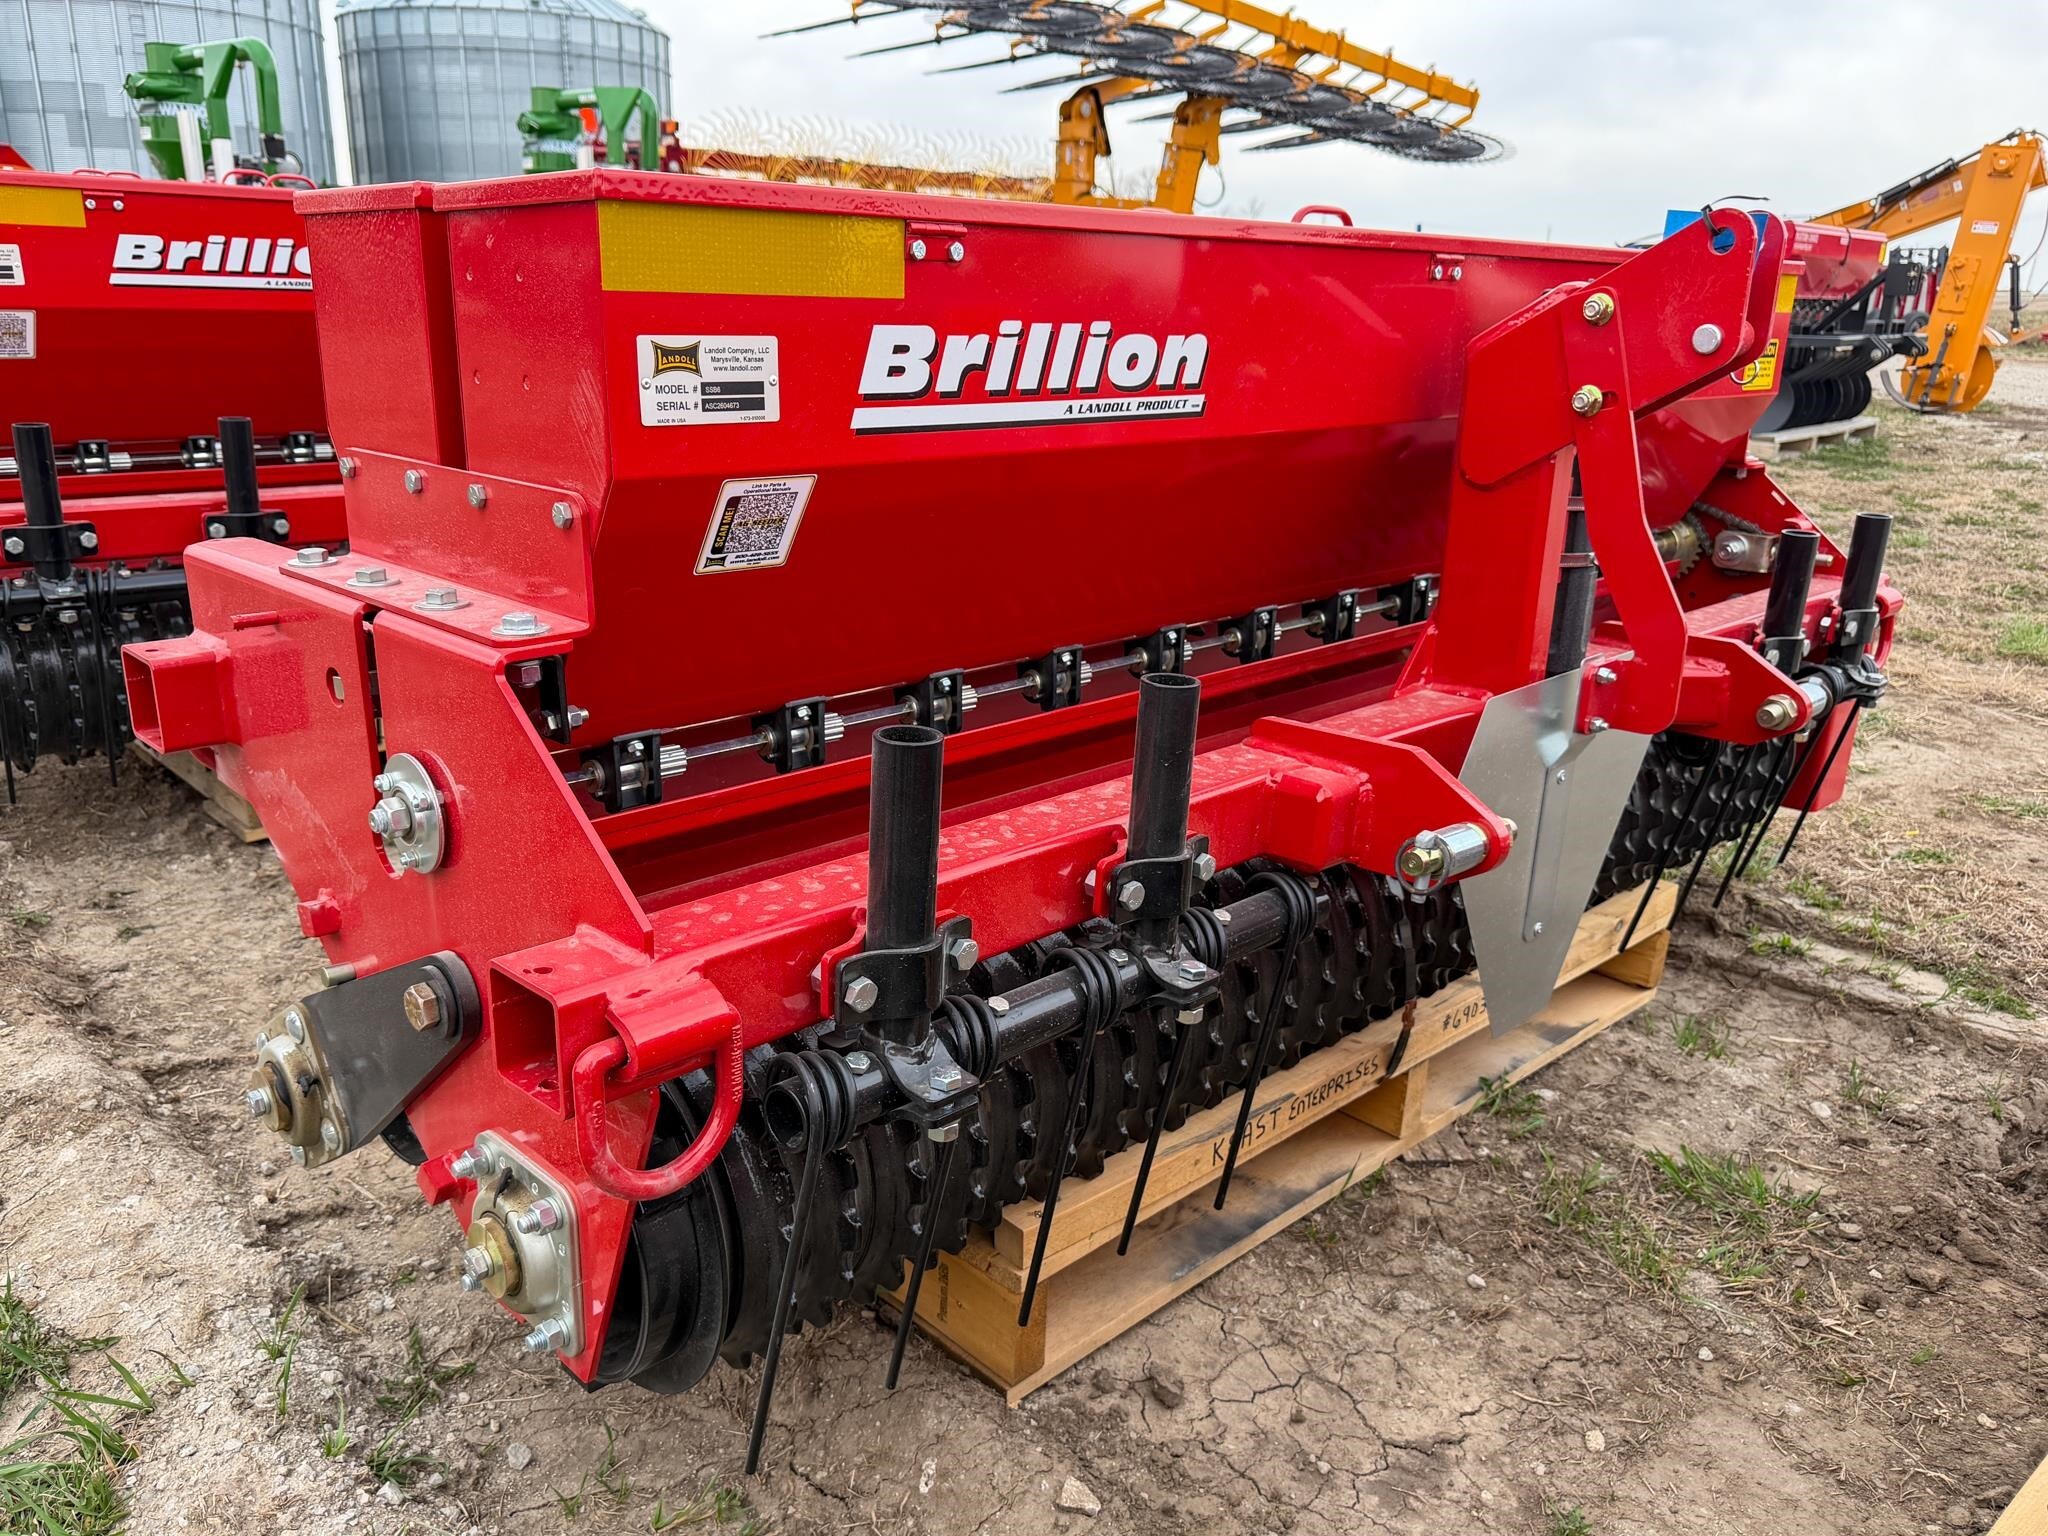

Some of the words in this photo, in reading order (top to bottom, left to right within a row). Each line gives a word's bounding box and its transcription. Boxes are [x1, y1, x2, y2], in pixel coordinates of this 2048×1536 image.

[704, 346, 726, 354] Landoll
[727, 346, 757, 356] Company,
[758, 346, 770, 354] LLC
[657, 349, 697, 370] LANDOLL
[710, 355, 742, 364] Marysville,
[743, 355, 765, 363] Kansas
[858, 320, 1209, 400] Brillion
[712, 364, 763, 372] www.landoll.com
[655, 384, 689, 395] MODEL
[692, 385, 698, 394] #
[656, 401, 691, 411] SERIAL
[693, 402, 699, 411] #
[1063, 404, 1073, 416] A
[1077, 401, 1132, 414] LANDOLL
[1135, 399, 1189, 411] PRODUCT
[743, 487, 771, 495] Operational
[715, 525, 729, 548] SCAN
[724, 507, 736, 524] ME!
[1211, 1107, 1282, 1167] KAST
